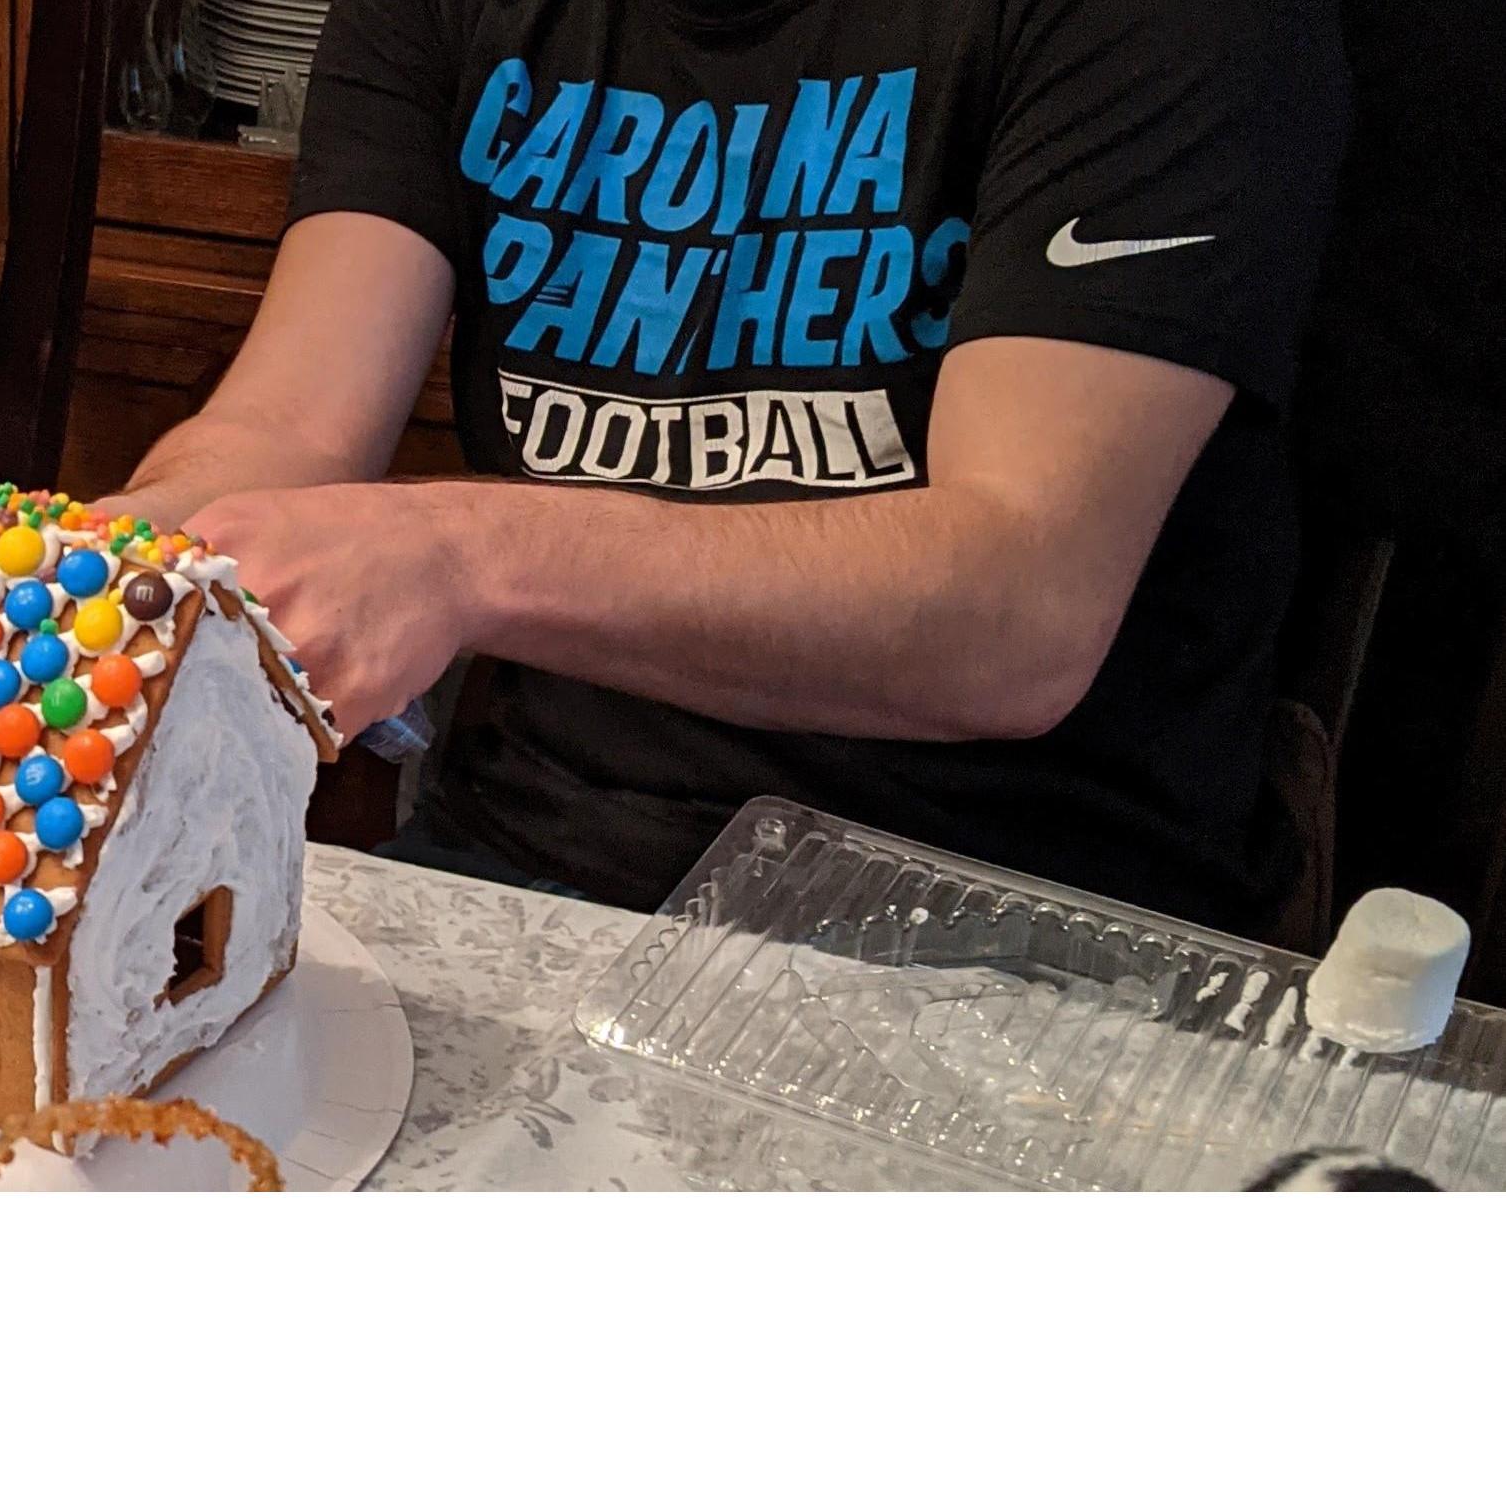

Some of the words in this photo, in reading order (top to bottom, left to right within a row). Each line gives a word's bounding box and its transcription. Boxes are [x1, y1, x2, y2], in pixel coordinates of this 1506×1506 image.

[460, 58, 917, 235] CAROLNA
[483, 213, 971, 375] PANHERS
[499, 376, 908, 488] FOOTBALL
